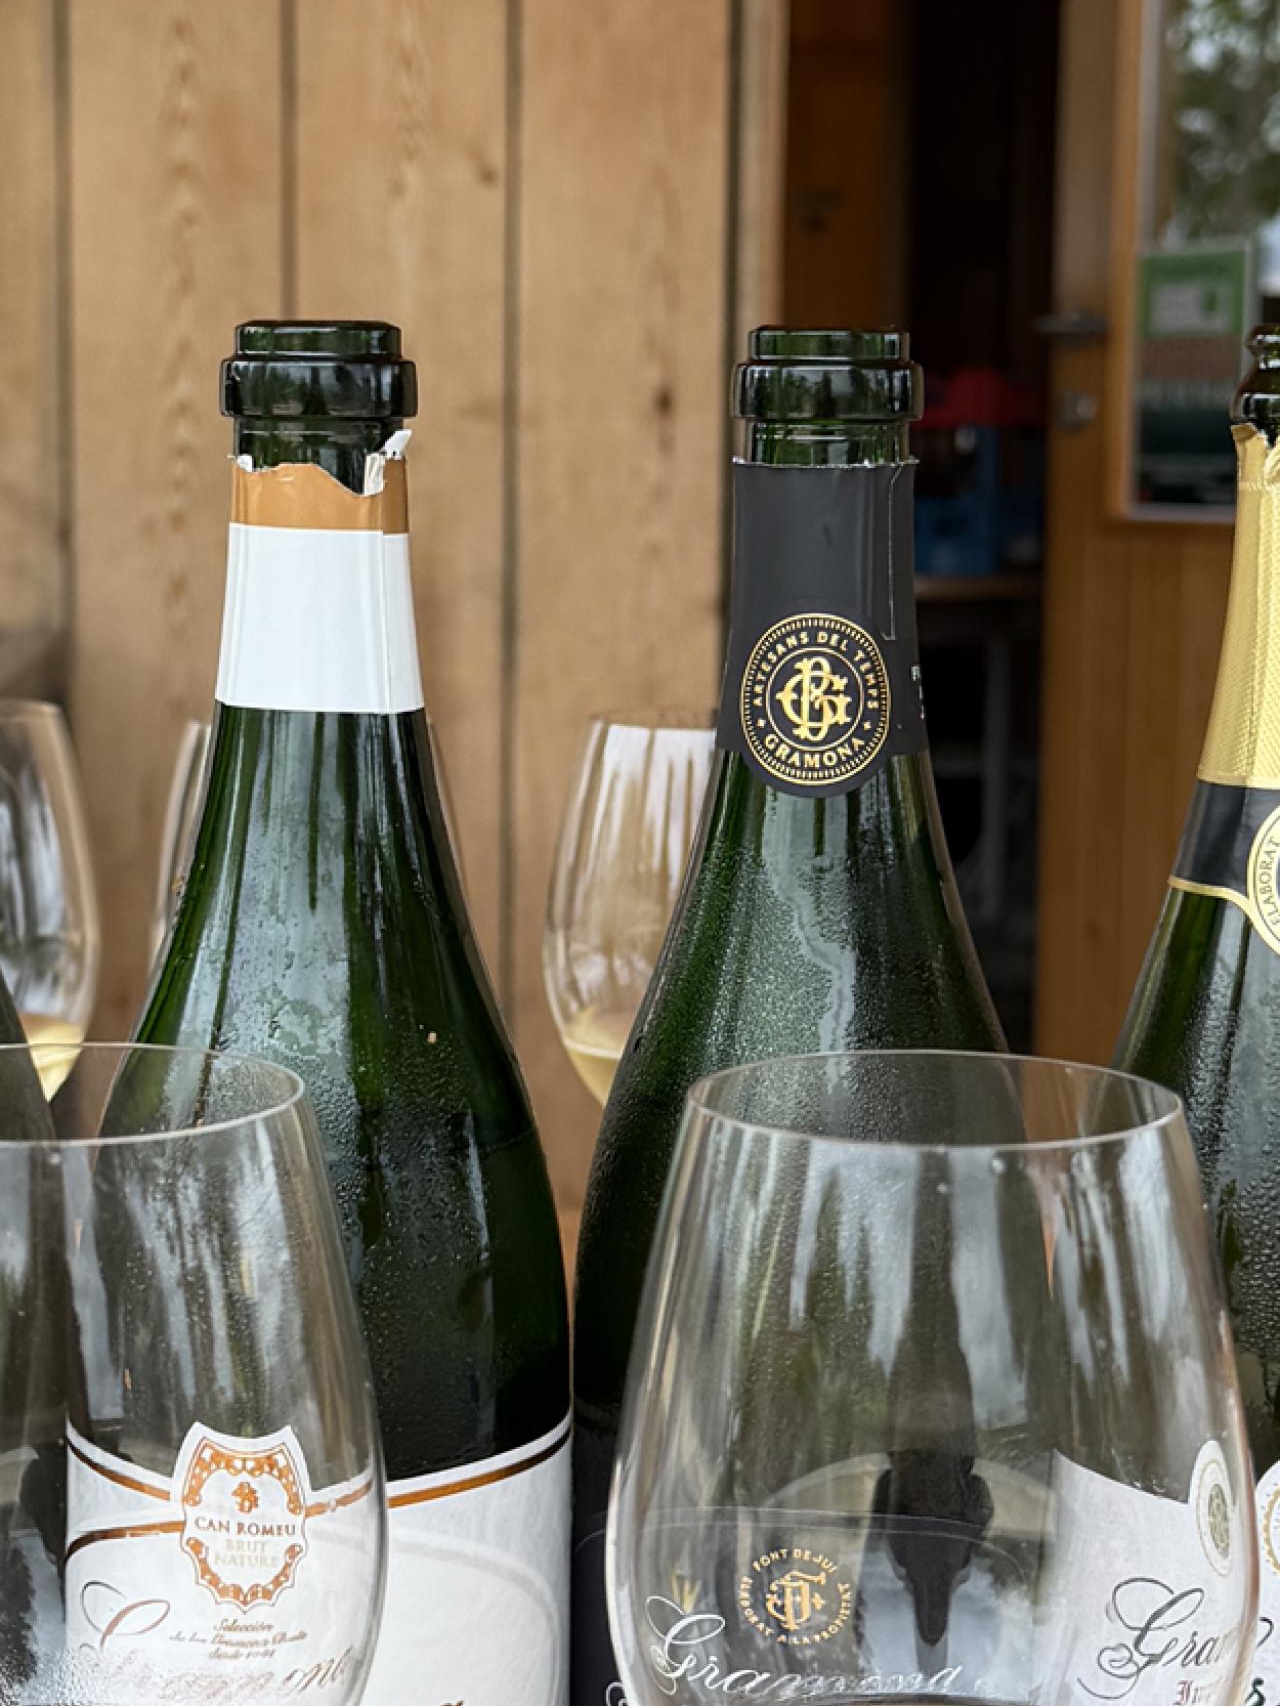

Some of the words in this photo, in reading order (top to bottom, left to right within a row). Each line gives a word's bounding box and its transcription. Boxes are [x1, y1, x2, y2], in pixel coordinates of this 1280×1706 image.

[753, 631, 809, 707] ARTESANS
[817, 631, 849, 652] DEL
[853, 649, 881, 710] TEMPS
[765, 733, 865, 768] GRAMONA
[194, 1516, 231, 1534] CAN
[236, 1520, 297, 1537] ROMEU
[225, 1538, 269, 1554] BRUT
[214, 1553, 280, 1568] NATURE
